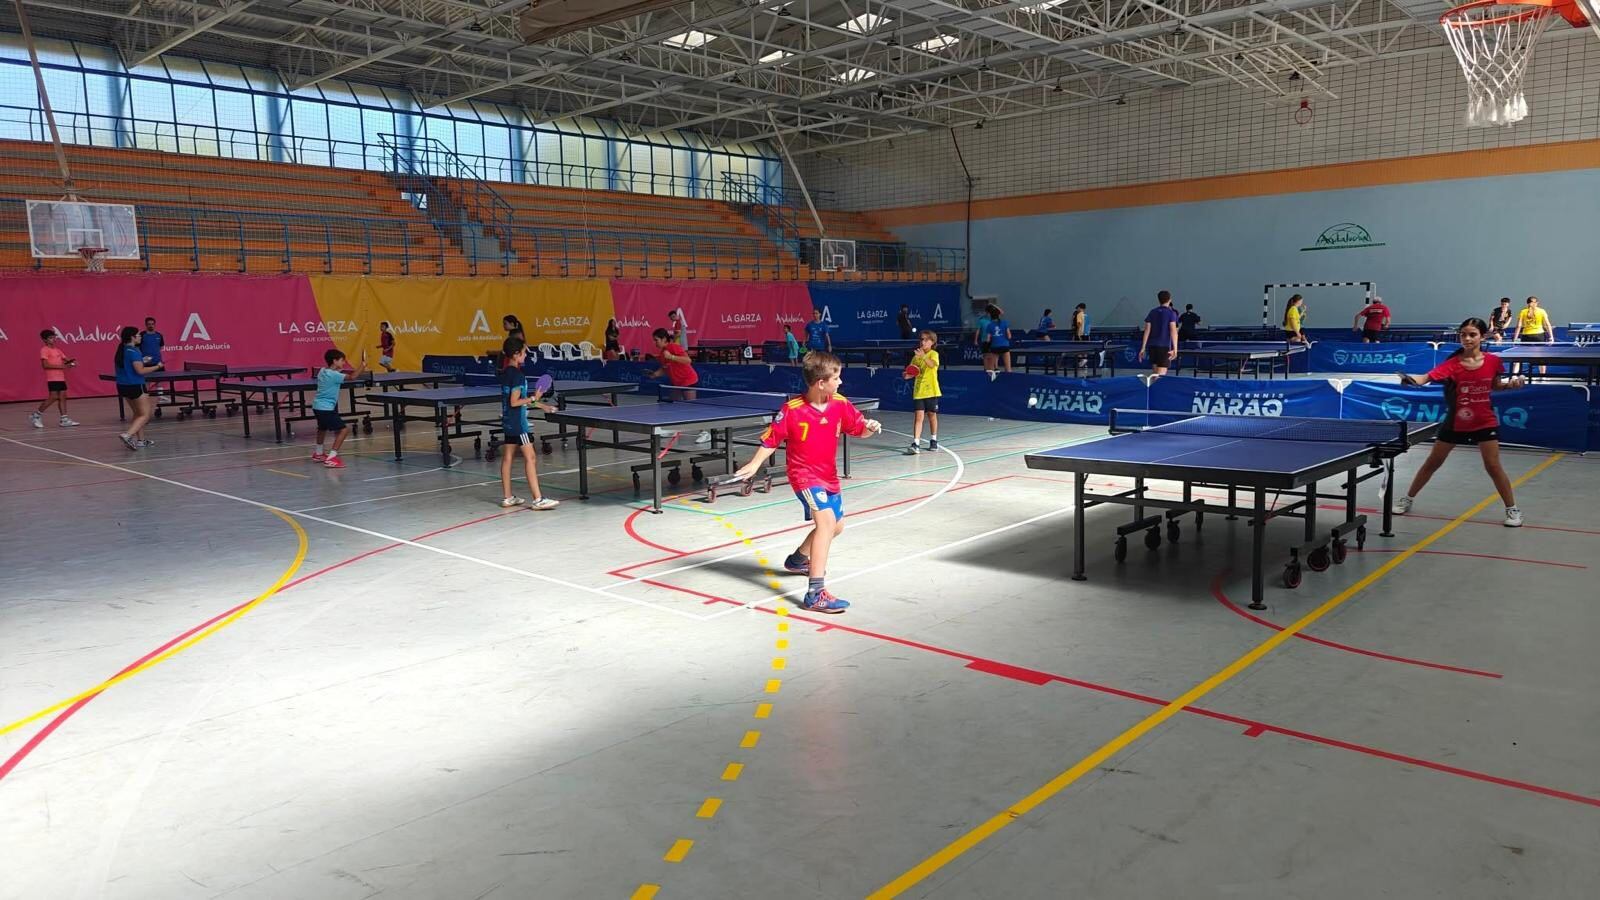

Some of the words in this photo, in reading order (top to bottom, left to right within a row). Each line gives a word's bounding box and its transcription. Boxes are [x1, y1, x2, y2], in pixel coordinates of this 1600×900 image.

[721, 314, 732, 323] LA
[734, 313, 762, 323] GARZA
[856, 311, 866, 319] LA
[866, 310, 888, 319] GARZA
[279, 322, 300, 333] LA
[304, 321, 358, 333] GARZA
[536, 317, 550, 328] LA
[553, 316, 591, 327] GARZA
[52, 325, 121, 344] Andalucí
[1351, 353, 1407, 365] NARAQ
[1030, 387, 1059, 395] TABLE
[1027, 393, 1103, 414] NARAQ
[1192, 397, 1283, 416] NARAQ
[798, 422, 809, 441] 7
